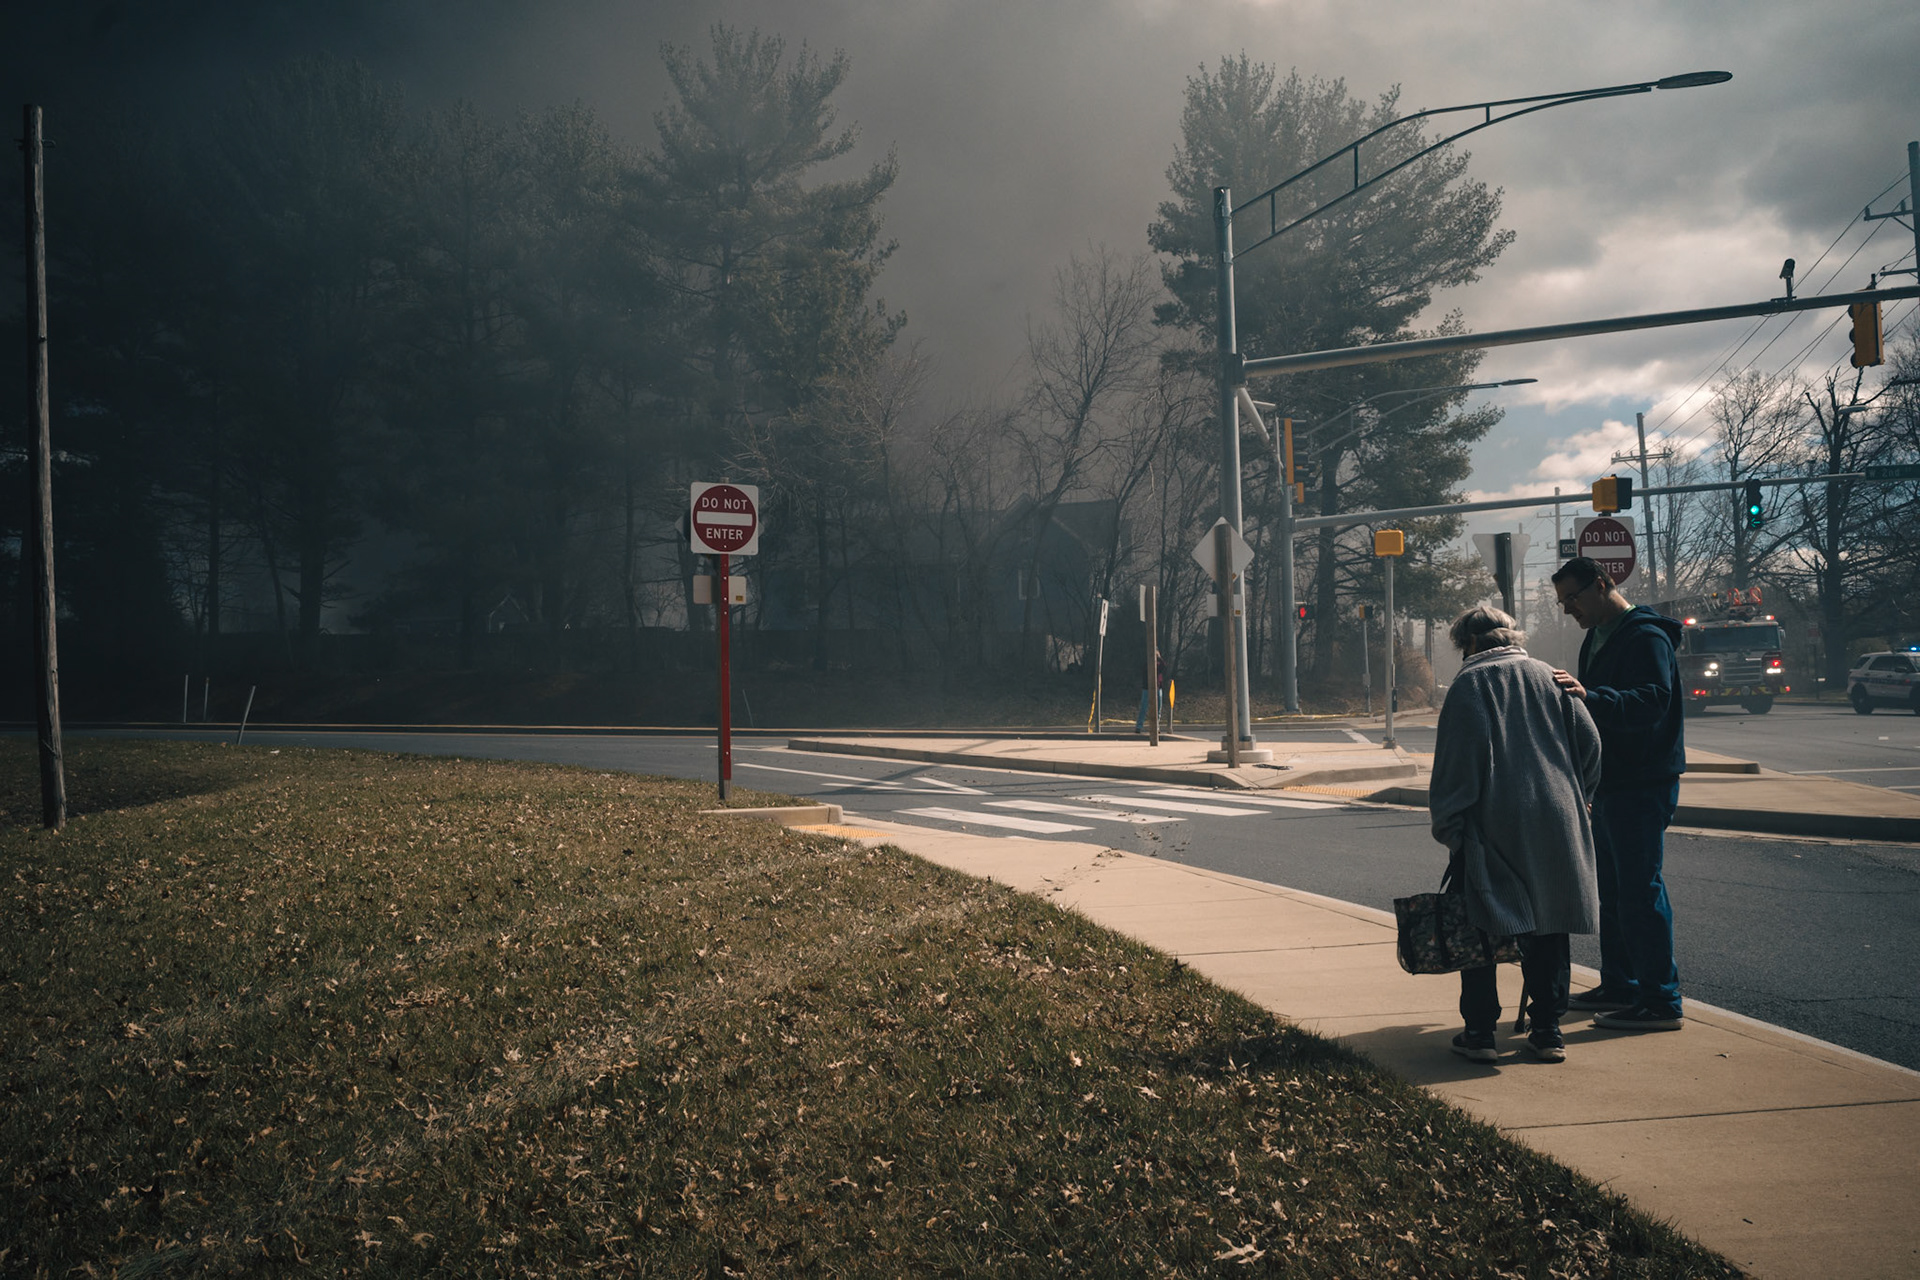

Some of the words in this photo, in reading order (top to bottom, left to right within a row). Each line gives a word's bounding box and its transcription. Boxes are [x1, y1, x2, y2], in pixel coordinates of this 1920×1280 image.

[702, 497, 719, 509] DO
[724, 499, 747, 510] NOT
[706, 528, 743, 540] ENTER
[1585, 531, 1600, 543] DO
[1605, 531, 1626, 542] NOT
